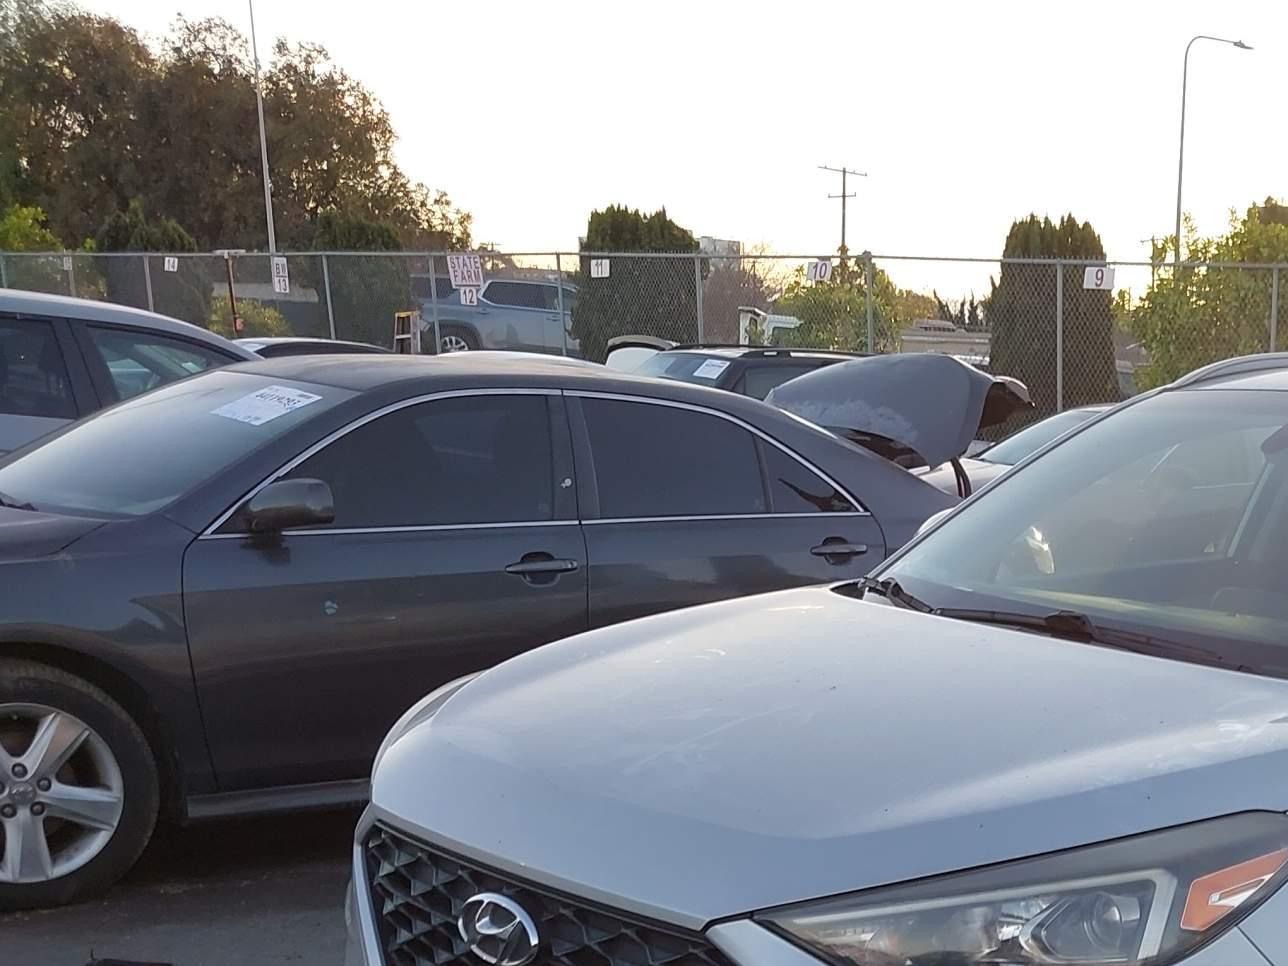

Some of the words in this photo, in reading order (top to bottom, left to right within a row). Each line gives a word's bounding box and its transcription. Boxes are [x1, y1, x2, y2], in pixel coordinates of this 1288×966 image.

[450, 256, 480, 270] STATE
[595, 260, 603, 276] 11
[812, 262, 828, 279] 10
[453, 270, 480, 283] FARM
[1095, 269, 1104, 287] 9
[278, 278, 287, 292] 13
[463, 289, 475, 304] 12
